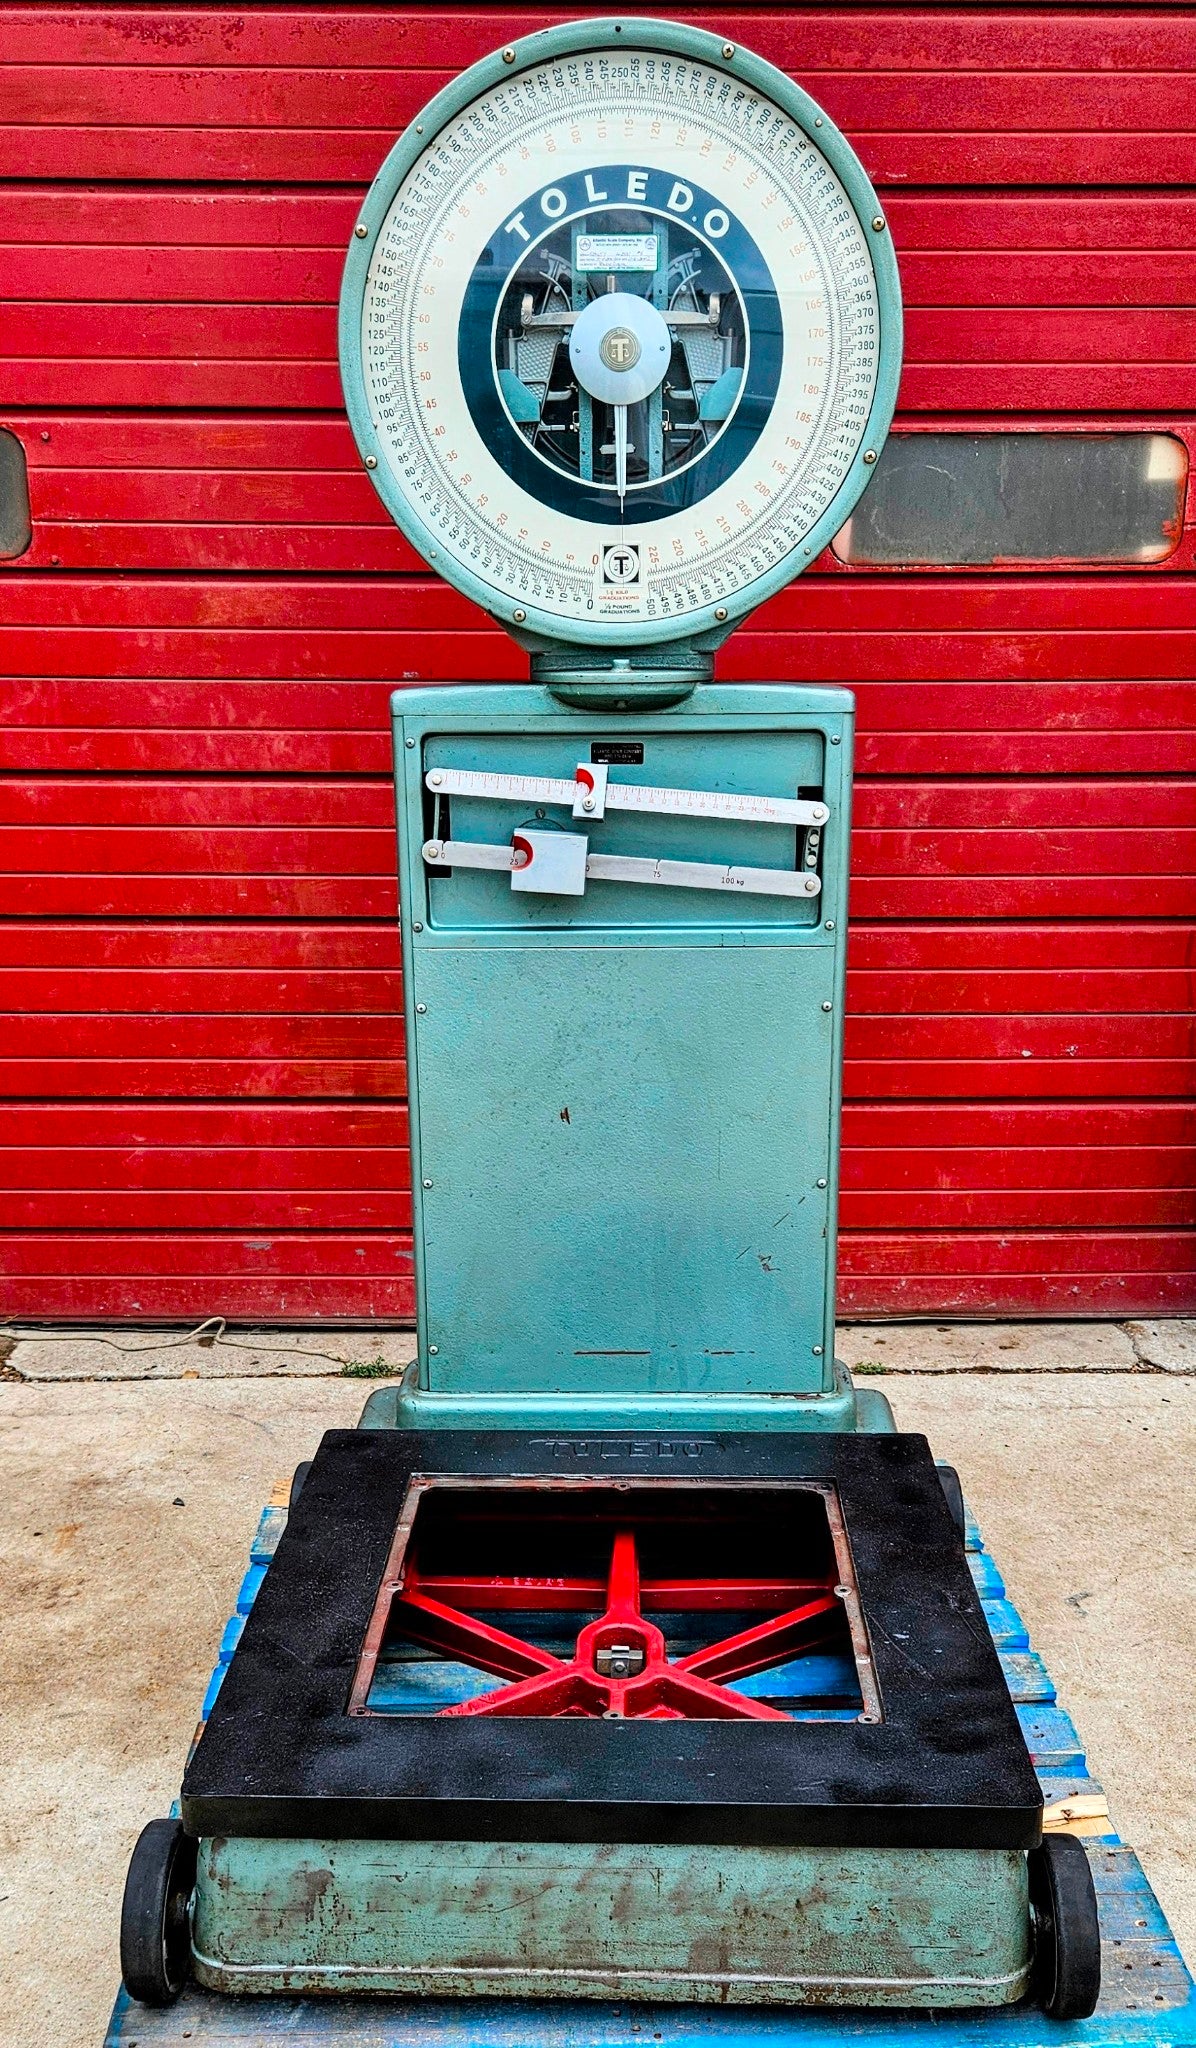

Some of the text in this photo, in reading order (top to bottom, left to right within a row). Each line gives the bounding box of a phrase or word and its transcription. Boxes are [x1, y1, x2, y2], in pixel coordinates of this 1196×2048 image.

[567, 60, 580, 83] 235
[583, 58, 594, 80] 240
[599, 56, 610, 78] 245
[611, 68, 629, 79] 250
[630, 56, 641, 76] 255
[646, 57, 657, 78] 260
[660, 59, 673, 81] 265
[551, 67, 565, 87] 230
[675, 64, 690, 84] 270
[690, 69, 702, 89] 275
[521, 78, 537, 98] 220
[537, 72, 550, 92] 225
[704, 76, 718, 96] 280
[508, 82, 522, 106] 215
[718, 82, 732, 103] 285
[731, 90, 746, 110] 290
[494, 91, 510, 113] 210
[744, 97, 759, 119] 295
[481, 102, 497, 122] 205
[756, 108, 772, 128] 300
[468, 112, 484, 131] 200
[768, 118, 786, 138] 305
[457, 122, 472, 142] 195
[780, 128, 796, 148] 310
[446, 134, 461, 153] 190
[790, 140, 810, 160] 315
[434, 144, 451, 164] 185
[424, 160, 440, 177] 180
[800, 154, 818, 172] 320
[414, 172, 431, 190] 175
[810, 166, 827, 185] 325
[407, 187, 423, 203] 170
[818, 181, 836, 198] 330
[399, 202, 415, 217] 165
[504, 171, 730, 242] TOLEDO
[826, 195, 844, 212] 335
[392, 216, 408, 231] 160
[833, 210, 850, 226] 340
[386, 232, 402, 246] 155
[839, 226, 856, 242] 345
[381, 247, 396, 261] 150
[844, 241, 862, 257] 350
[377, 264, 392, 277] 145
[849, 258, 866, 272] 355
[374, 280, 389, 293] 140
[853, 274, 870, 288] 360
[370, 296, 386, 308] 135
[856, 291, 872, 303] 365
[369, 312, 385, 324] 130
[858, 308, 874, 319] 370
[368, 330, 384, 340] 125
[859, 325, 875, 336] 375
[368, 346, 384, 356] 120
[418, 342, 429, 351] 55
[611, 339, 629, 361] T
[859, 342, 875, 351] 380
[370, 362, 385, 373] 115
[857, 358, 873, 368] 385
[372, 377, 387, 389] 110
[420, 371, 431, 380] 50
[855, 374, 872, 384] 390
[804, 384, 820, 395] 180
[853, 389, 868, 400] 395
[374, 393, 390, 405] 105
[426, 398, 437, 409] 45
[378, 408, 394, 420] 100
[796, 411, 812, 424] 185
[849, 405, 866, 416] 400
[386, 423, 397, 435] 95
[434, 426, 446, 436] 40
[845, 420, 861, 432] 405
[392, 438, 403, 450] 90
[785, 436, 801, 450] 190
[840, 435, 856, 448] 410
[398, 452, 409, 464] 85
[446, 450, 457, 462] 35
[834, 449, 850, 463] 415
[404, 466, 416, 478] 80
[772, 460, 786, 475] 195
[827, 464, 843, 478] 420
[411, 479, 423, 492] 75
[460, 474, 472, 486] 30
[820, 477, 836, 492] 425
[754, 481, 771, 497] 200
[419, 492, 432, 504] 70
[477, 494, 489, 507] 25
[812, 490, 827, 505] 430
[430, 504, 440, 517] 65
[736, 500, 752, 517] 205
[802, 503, 818, 518] 435
[439, 516, 450, 529] 60
[497, 513, 509, 526] 20
[716, 516, 731, 534] 210
[793, 515, 808, 531] 440
[448, 528, 460, 540] 55
[518, 528, 529, 540] 15
[694, 530, 709, 547] 215
[784, 526, 799, 544] 445
[458, 538, 470, 550] 50
[541, 541, 552, 554] 10
[672, 540, 684, 557] 220
[773, 537, 788, 553] 450
[470, 548, 481, 560] 45
[592, 555, 600, 566] 0
[648, 546, 660, 564] 225
[762, 547, 777, 563] 455
[482, 557, 492, 569] 40
[614, 556, 629, 574] T
[750, 556, 764, 572] 460
[493, 565, 504, 577] 35
[505, 572, 516, 584] 30
[739, 564, 752, 580] 465
[519, 579, 529, 591] 25
[714, 578, 726, 595] 475
[726, 571, 739, 588] 470
[532, 584, 542, 597] 20
[545, 589, 555, 600] 15
[687, 589, 699, 606] 485
[700, 584, 712, 601] 480
[559, 594, 568, 603] 10
[587, 601, 594, 610] 0
[660, 597, 671, 614] 495
[674, 593, 685, 610] 490
[646, 599, 657, 616] 500
[545, 1442, 703, 1457] TOLEDO
